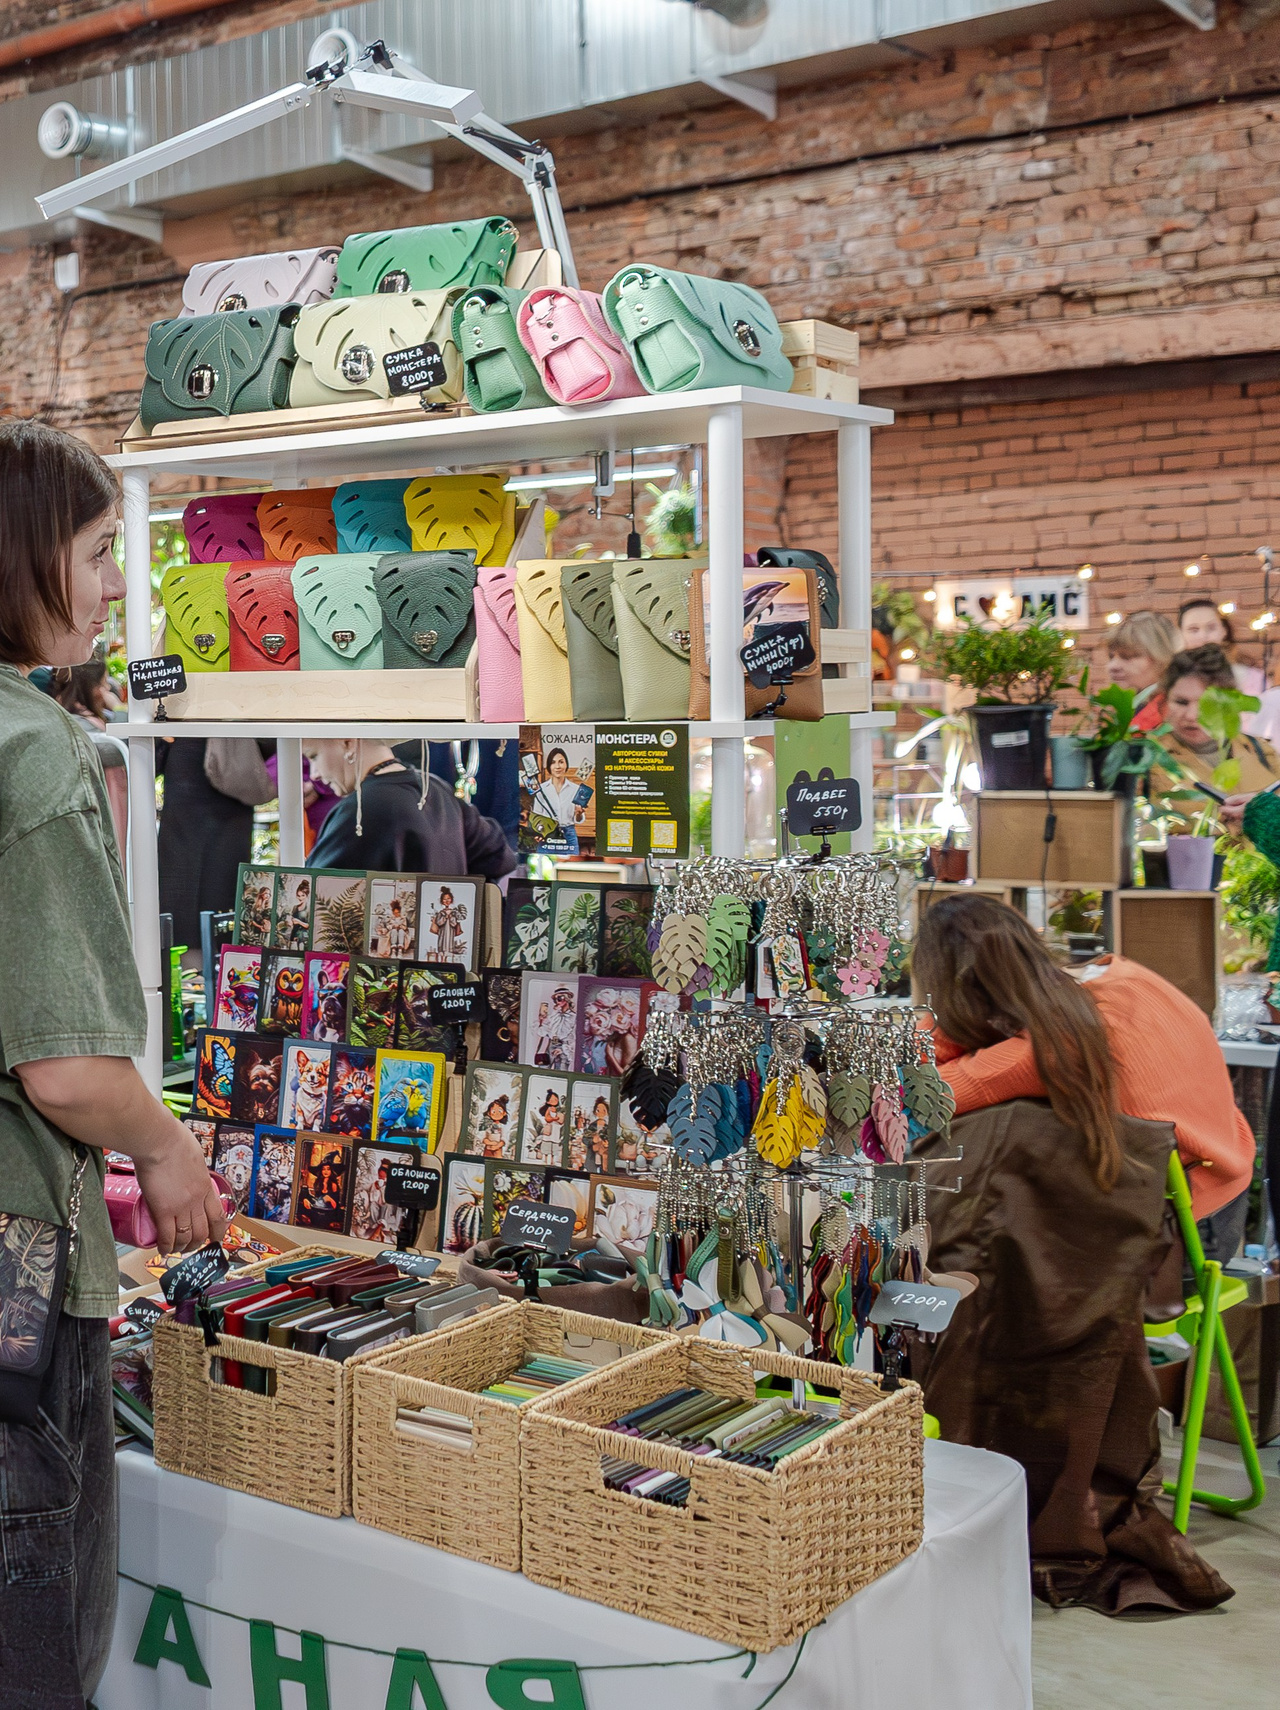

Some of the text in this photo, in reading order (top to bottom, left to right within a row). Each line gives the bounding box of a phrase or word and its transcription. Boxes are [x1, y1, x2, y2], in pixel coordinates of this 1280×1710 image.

[386, 348, 423, 364] СУМКА
[387, 354, 441, 376] МОНСТЕРА
[744, 635, 786, 660] СУМКА
[131, 659, 165, 671] СУМКА
[596, 734, 658, 745] МОНСТЕРА
[381, 1250, 435, 1263] БРАСЛЕТ
